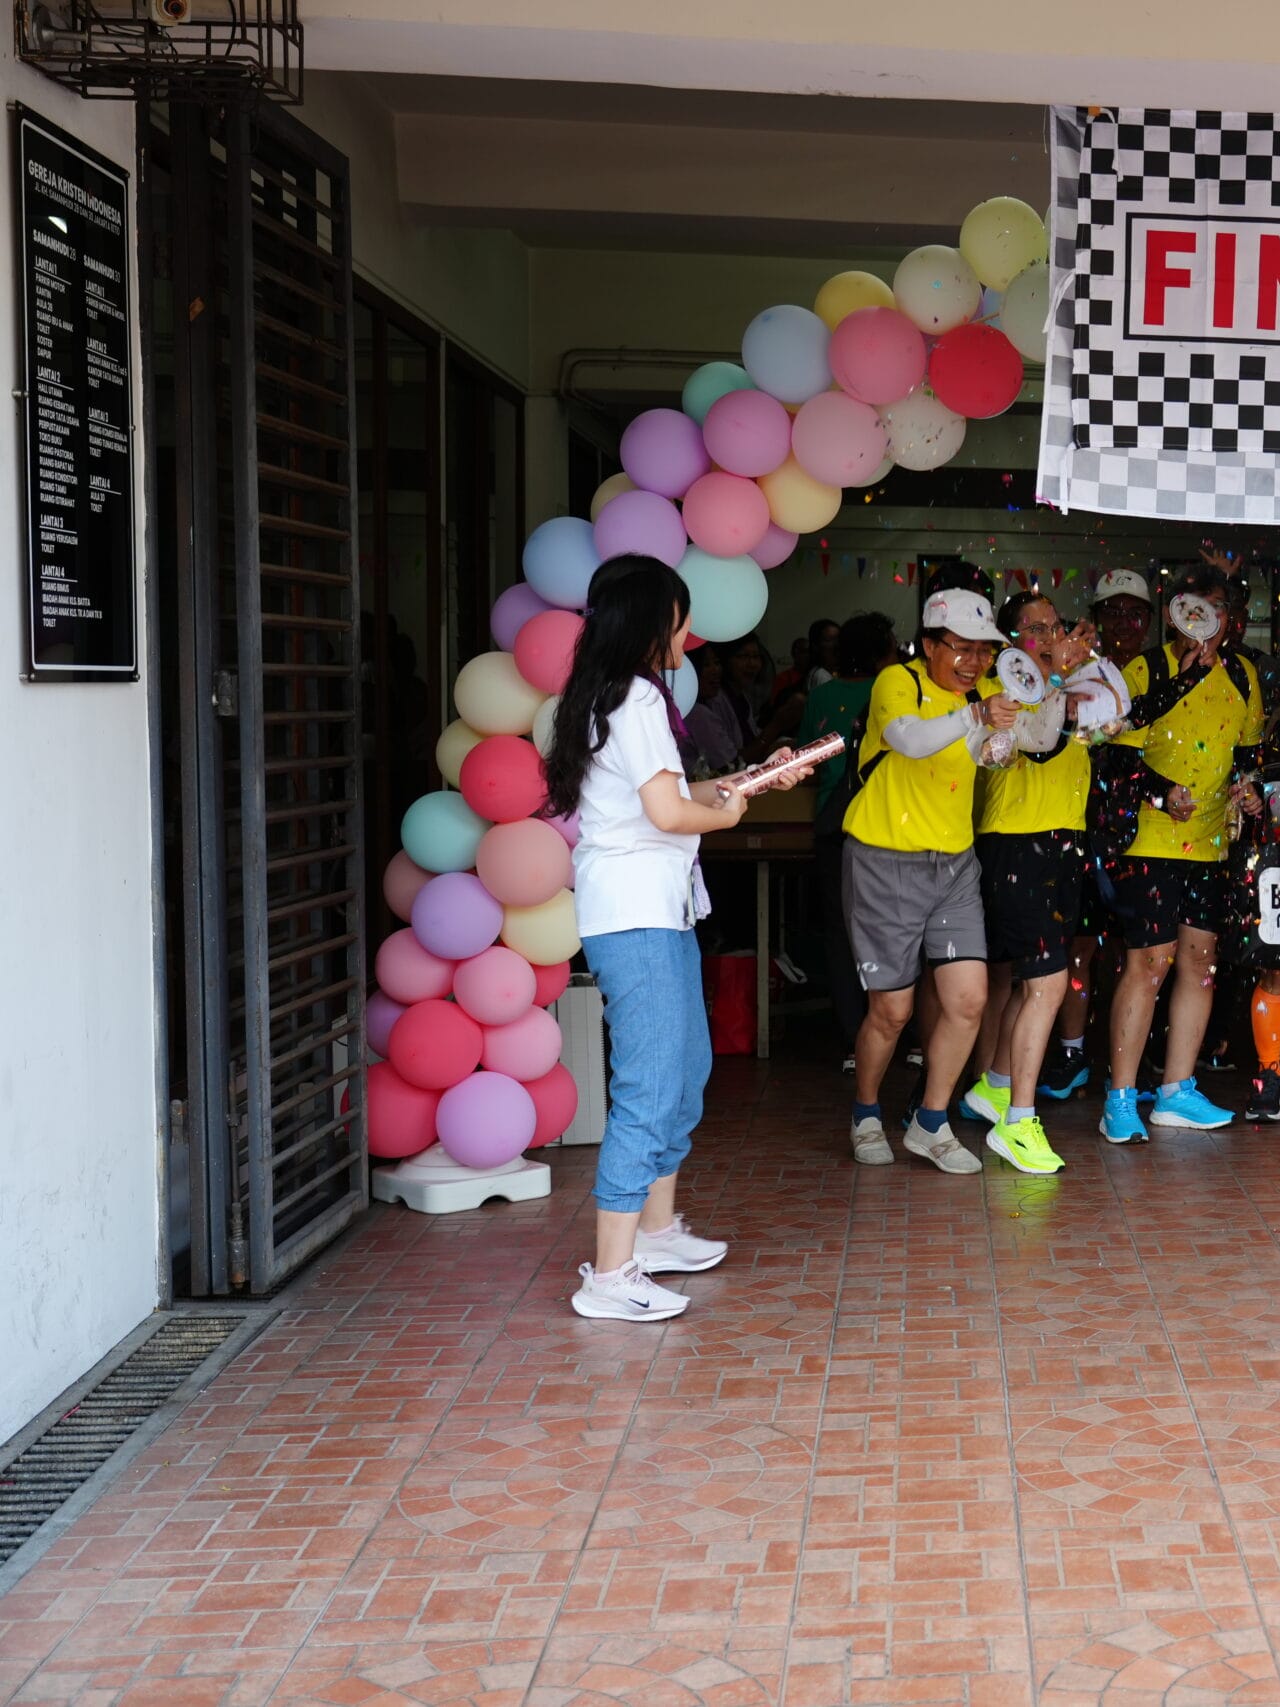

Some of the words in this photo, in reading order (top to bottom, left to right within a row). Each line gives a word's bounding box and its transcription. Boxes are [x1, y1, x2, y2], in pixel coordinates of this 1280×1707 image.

[29, 160, 58, 188] GEREJA
[57, 176, 87, 206] KRISTEN
[87, 194, 121, 226] INDONESIA
[48, 189, 73, 210] SAMANHUDI
[80, 205, 88, 218] DAN
[94, 214, 110, 232] JAKARTA
[33, 229, 69, 257] SAMANHUDI
[69, 247, 76, 261] 28
[36, 255, 54, 274] LANTAI
[84, 254, 114, 280] SAMANHUDI
[115, 269, 120, 283] 30
[36, 273, 50, 287] PARKIR
[51, 280, 65, 294] MOTOR
[86, 280, 102, 297] LANTAI
[36, 285, 51, 299] KANTIN
[37, 298, 47, 310] AULA
[86, 295, 98, 309] PARKIR
[99, 302, 111, 314] MOTOR
[87, 307, 98, 320] TOILET
[37, 310, 51, 323] RUANG
[63, 320, 74, 332] ANAK
[37, 322, 50, 335] TOILET
[37, 334, 52, 348] KOSTER
[87, 336, 103, 353] LANTAI
[37, 346, 51, 360] DAPUR
[37, 365, 56, 382] LANTAI
[88, 365, 102, 379] KANTOR
[88, 376, 99, 389] TOILET
[38, 383, 48, 394] HALL
[48, 386, 63, 398] UTAMA
[38, 394, 53, 407] RUANG
[38, 407, 55, 420] KANTOR
[55, 411, 66, 422] TATA
[66, 415, 80, 427] USAHA
[88, 406, 105, 422] LANTAI
[39, 431, 51, 443] TOKO
[51, 434, 62, 446] BUKU
[89, 434, 102, 446] RUANG
[39, 443, 53, 455] RUANG
[54, 447, 74, 461] PASTORAL
[89, 446, 102, 458] TOILET
[39, 456, 54, 467] RUANG
[54, 459, 67, 471] RAPAT
[39, 468, 54, 480] RUANG
[39, 480, 54, 492] RUANG
[90, 474, 106, 489] LANTAI
[40, 492, 54, 504] RUANG
[90, 491, 100, 501] AULA
[90, 502, 102, 513] TOILET
[40, 513, 59, 528] LANTAI
[41, 531, 55, 542] RUANG
[41, 543, 55, 553] TOILET
[41, 564, 60, 577] LANTAI
[60, 566, 65, 578] 4
[42, 581, 56, 592] RUANG
[43, 617, 56, 628] TOILET
